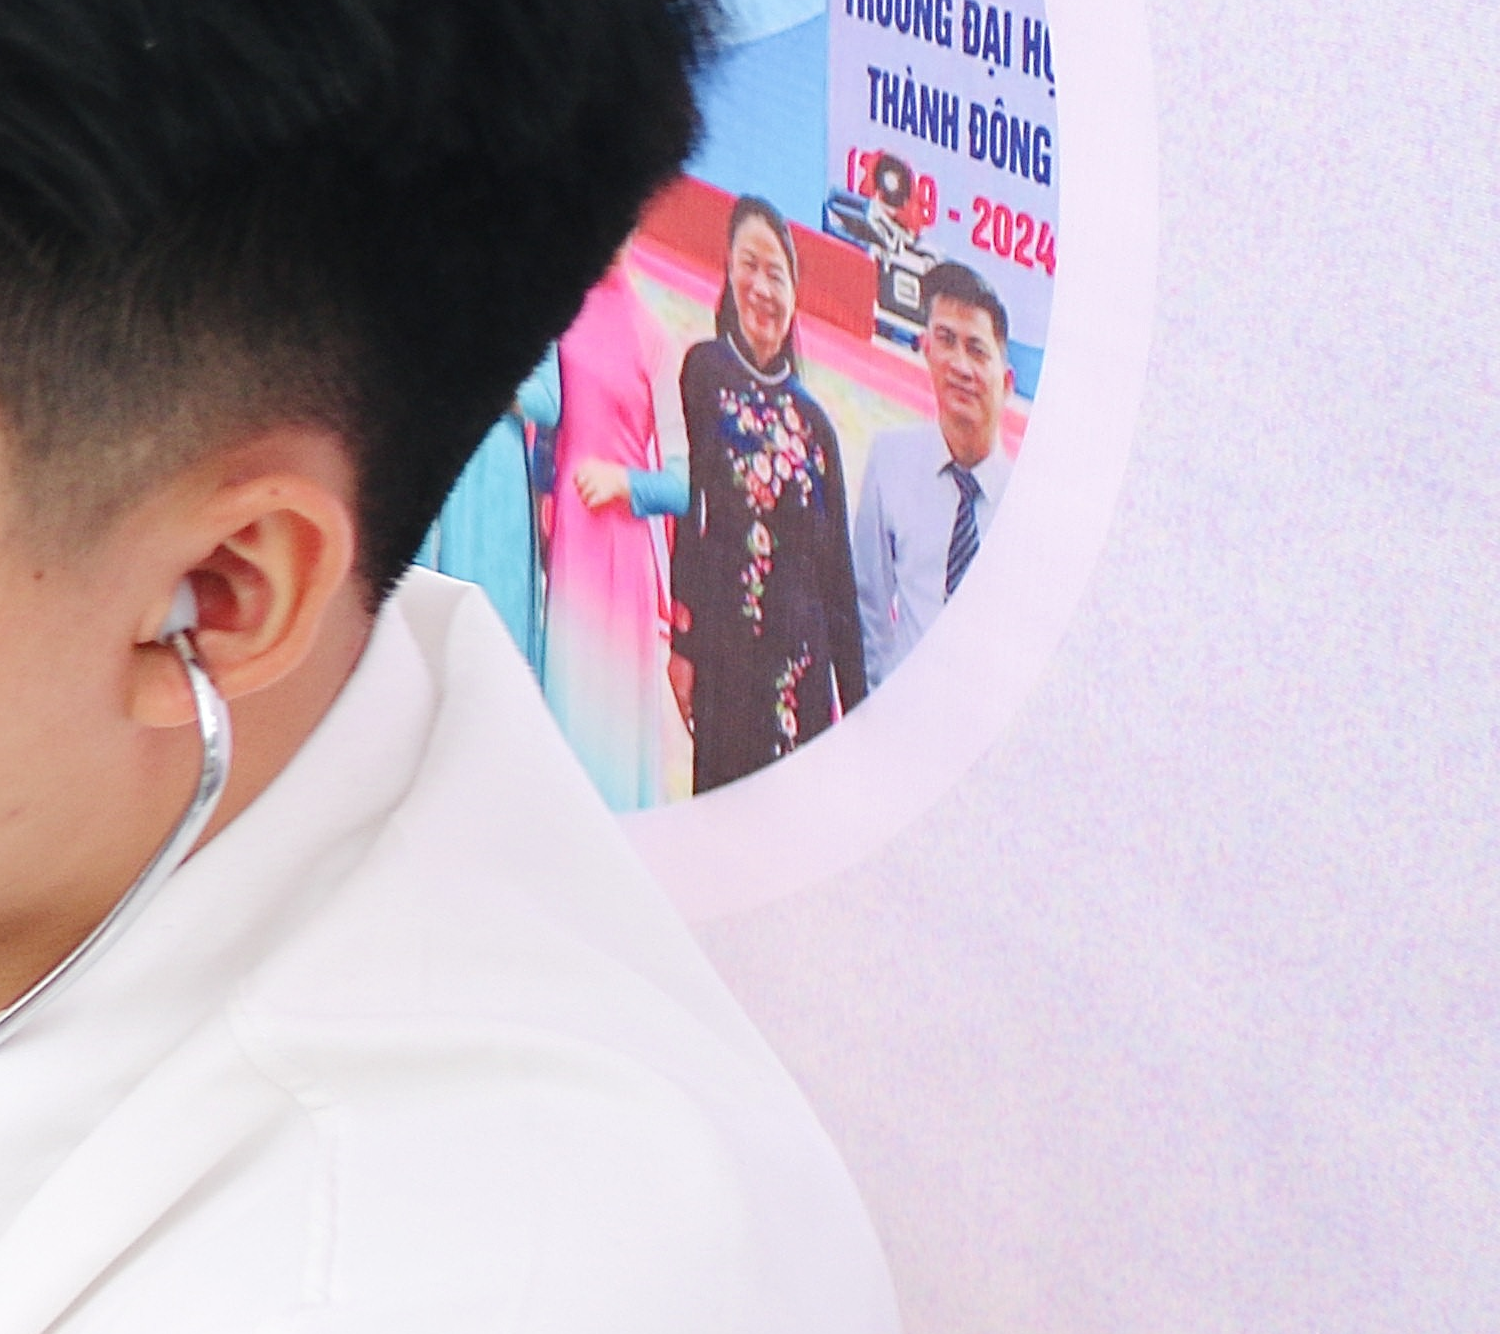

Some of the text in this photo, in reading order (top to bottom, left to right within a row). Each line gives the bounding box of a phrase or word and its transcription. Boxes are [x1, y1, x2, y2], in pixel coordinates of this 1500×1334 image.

[867, 65, 1052, 187] THÀNH ĐÔNG
[970, 195, 1058, 280] 2024
